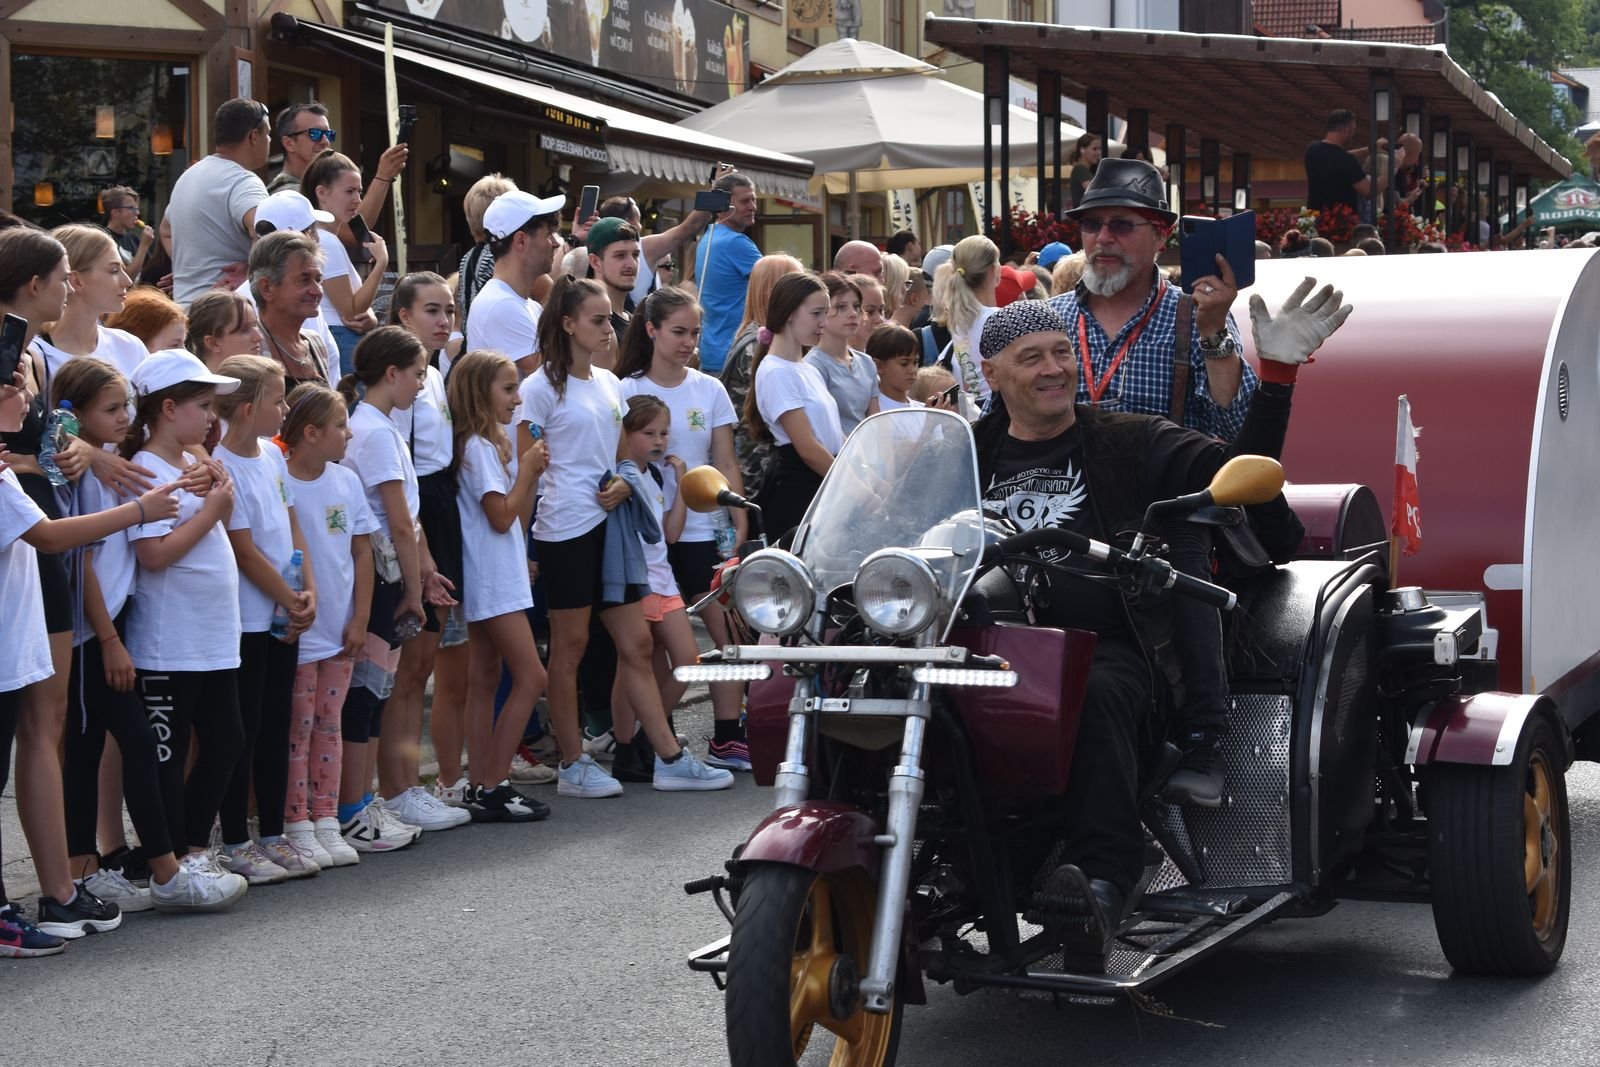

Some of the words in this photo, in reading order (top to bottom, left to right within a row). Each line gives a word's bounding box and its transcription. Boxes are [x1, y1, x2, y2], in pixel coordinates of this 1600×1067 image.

[541, 134, 555, 151] TOP
[556, 140, 583, 157] BELGIAN
[1017, 498, 1035, 520] 6
